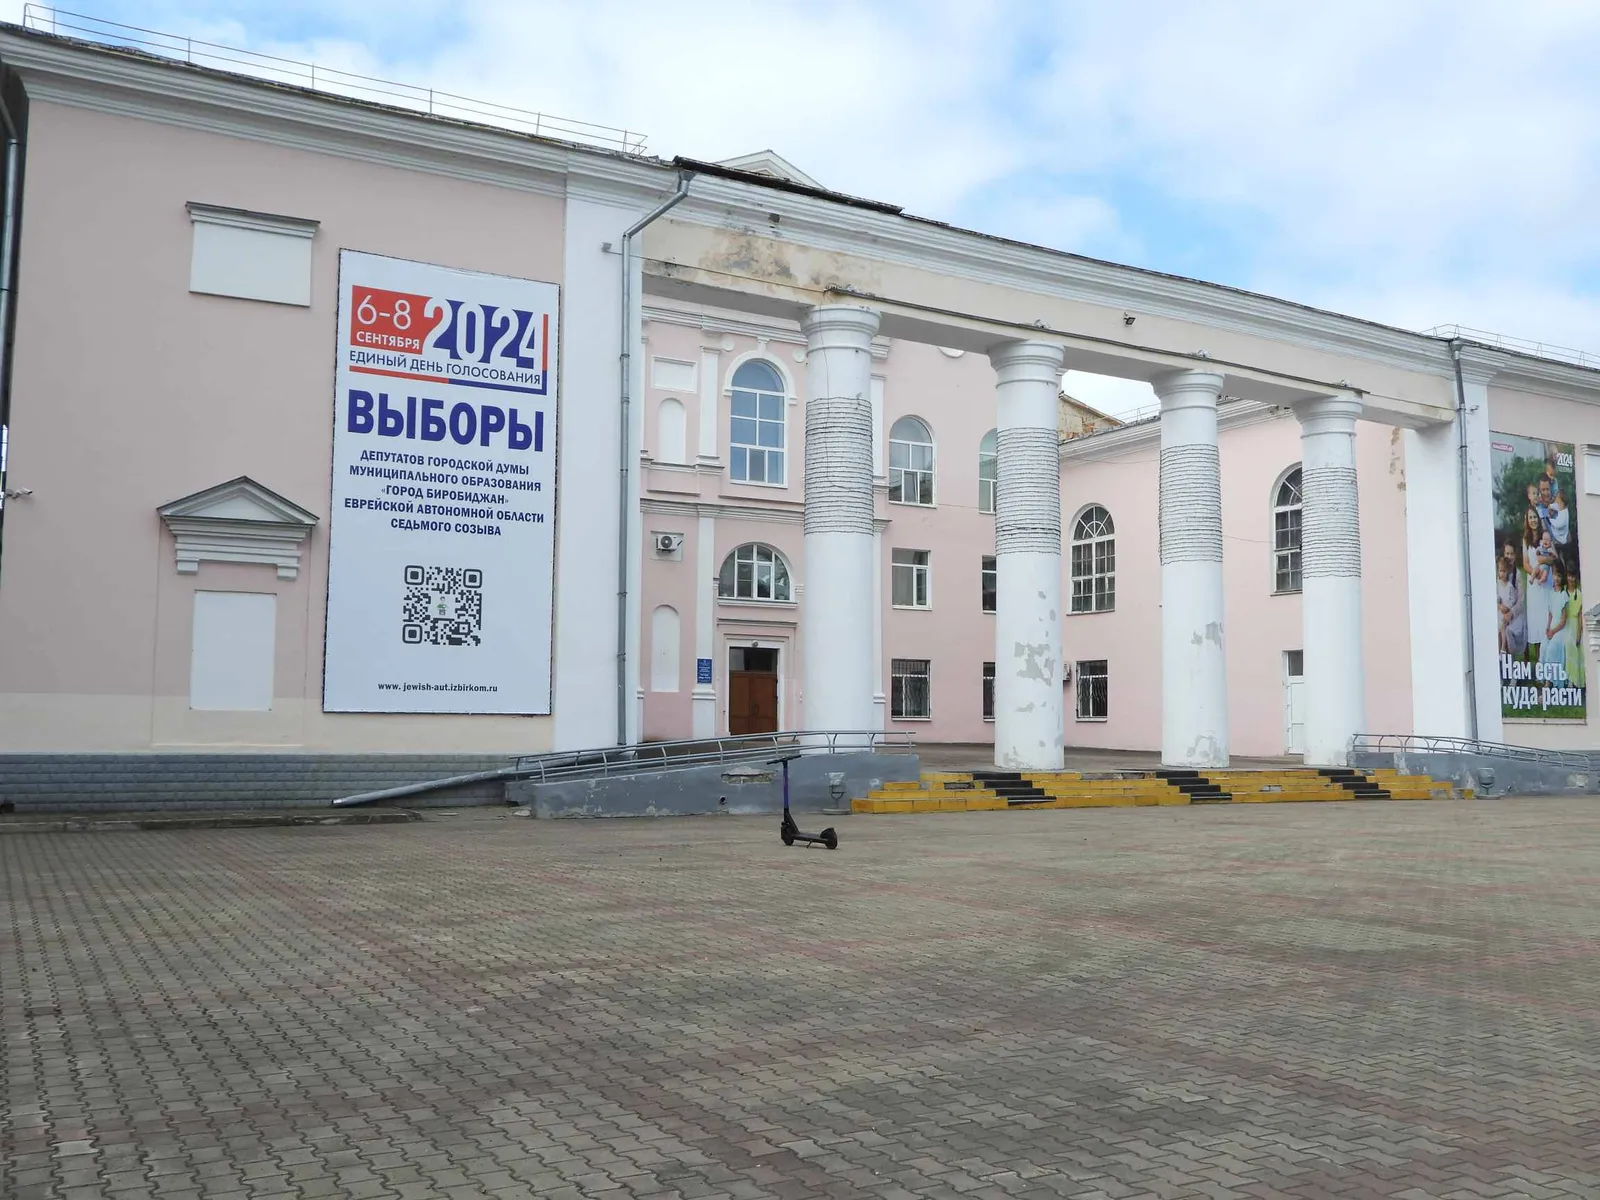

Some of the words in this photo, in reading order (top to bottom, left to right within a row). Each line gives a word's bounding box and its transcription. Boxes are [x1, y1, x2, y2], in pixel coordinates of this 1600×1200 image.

[356, 331, 420, 350] СЕНТЯБРЯ
[422, 297, 542, 369] 2024
[350, 351, 407, 368] ЕДИНЫЙ
[410, 358, 443, 373] ДЕНЬ
[446, 363, 541, 385] ГОЛОСОВАНИЯ
[347, 389, 544, 452] ВЫБОРЫ
[360, 450, 425, 466] ДЕПУТАТОВ
[427, 456, 493, 472] ГОРОДСКОЙ
[496, 463, 529, 475] ДУМЫ
[1557, 453, 1573, 467] 2024
[349, 465, 459, 485] МУНИЦИПАЛЬНОГО
[461, 476, 541, 492] ОБРАЗОВАНИЯ
[344, 498, 414, 514] ЕВРЕЙСКОЙ
[417, 504, 494, 520] АВТОНОМНОЙ
[496, 510, 544, 523] ОБЛАСТИ
[390, 518, 451, 533] СЕДЬМОГО
[454, 524, 501, 536] СОЗЫВА
[1502, 654, 1531, 680] Нам
[1535, 662, 1567, 680] есть
[1502, 686, 1538, 710] куда
[1542, 687, 1582, 711] расти
